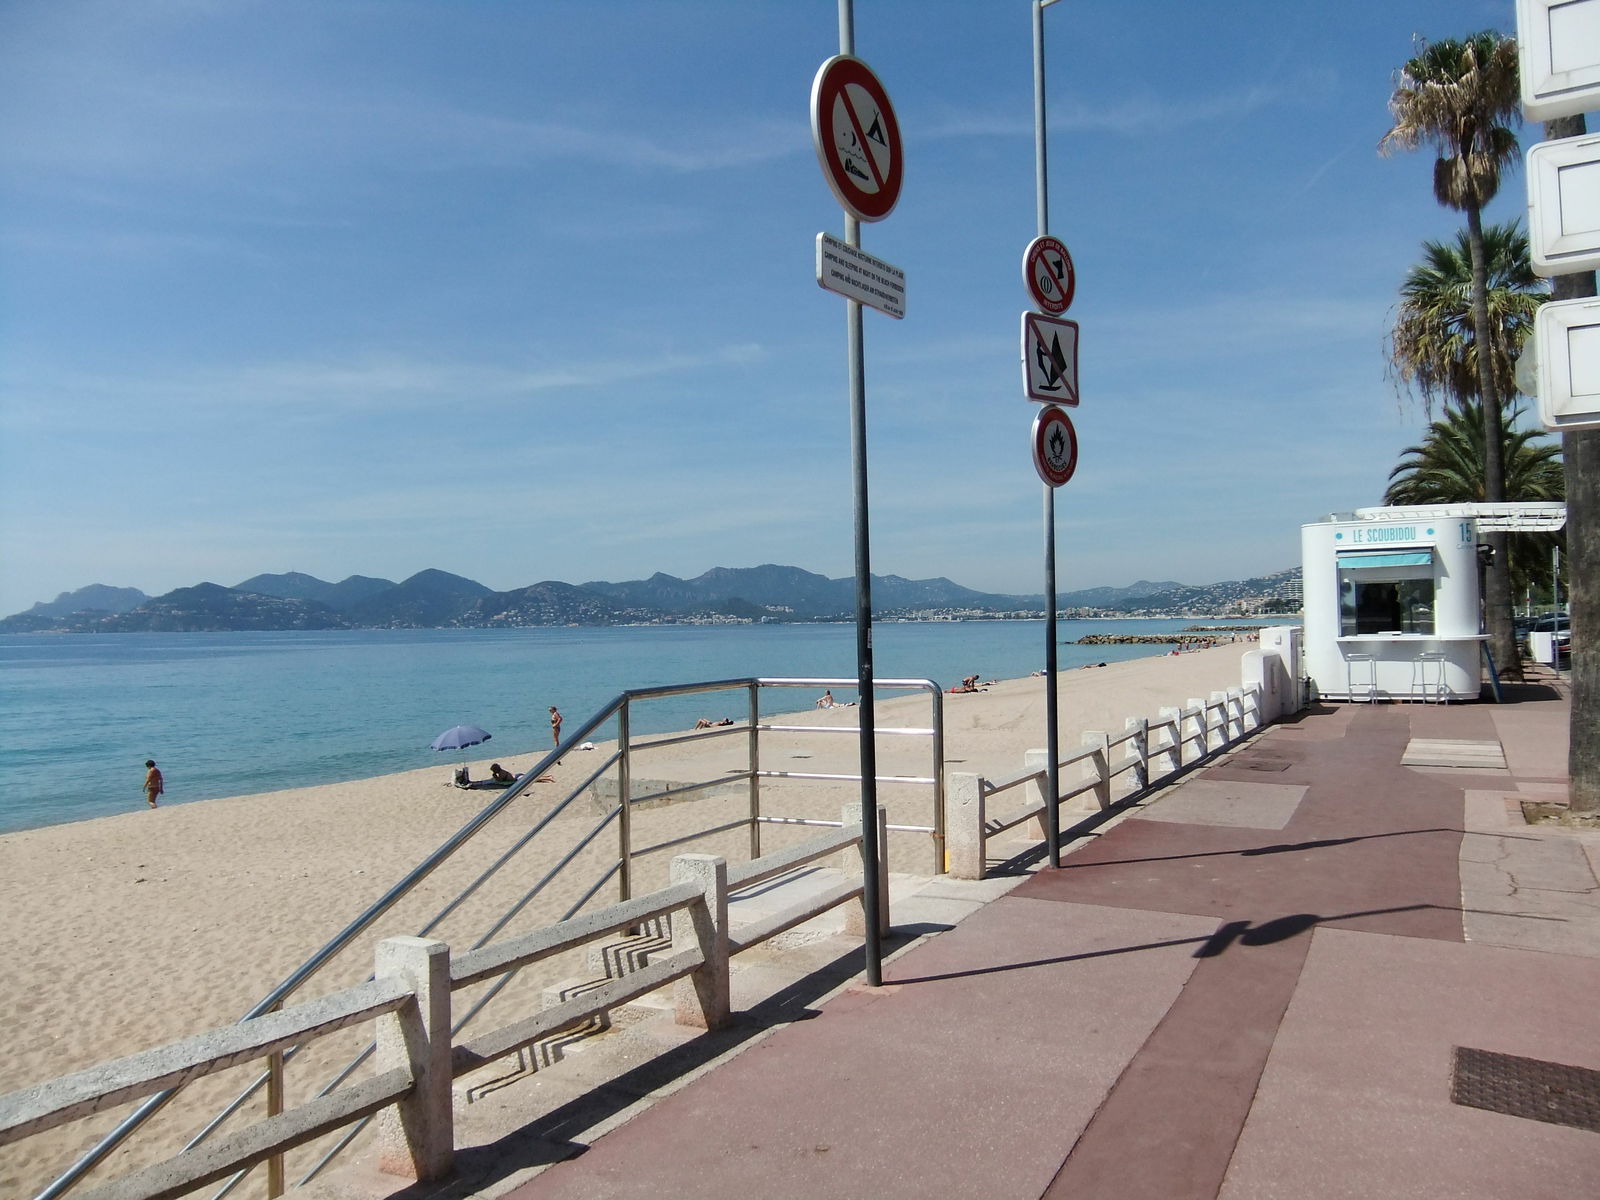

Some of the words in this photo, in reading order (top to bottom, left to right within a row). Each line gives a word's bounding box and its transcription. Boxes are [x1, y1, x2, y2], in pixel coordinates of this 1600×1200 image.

[1353, 529, 1363, 543] LE
[1367, 526, 1417, 542] SCOUBIDOU
[1458, 522, 1472, 543] 15
